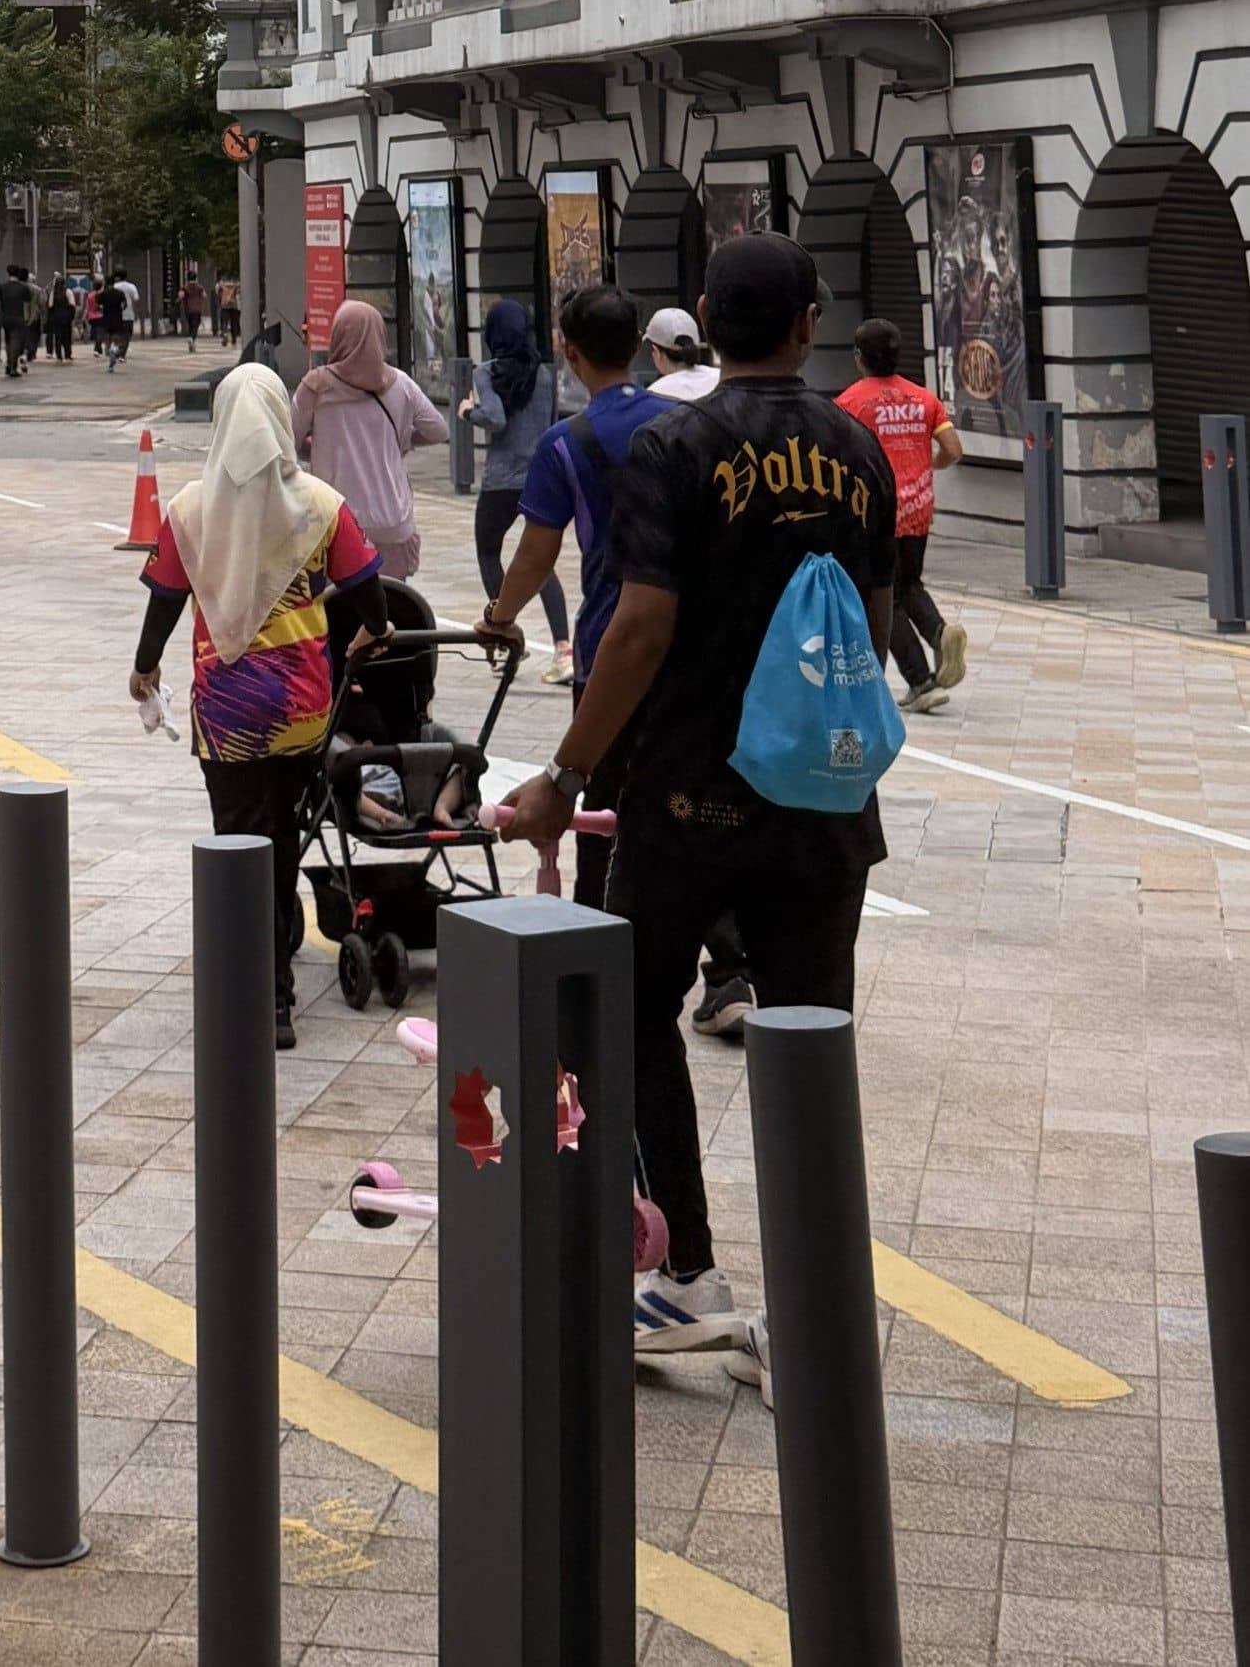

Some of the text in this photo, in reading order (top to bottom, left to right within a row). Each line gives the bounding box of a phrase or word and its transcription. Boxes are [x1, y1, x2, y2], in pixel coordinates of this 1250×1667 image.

[875, 403, 926, 425] 21KM
[878, 422, 928, 435] FINISHER
[713, 435, 872, 529] Voltra
